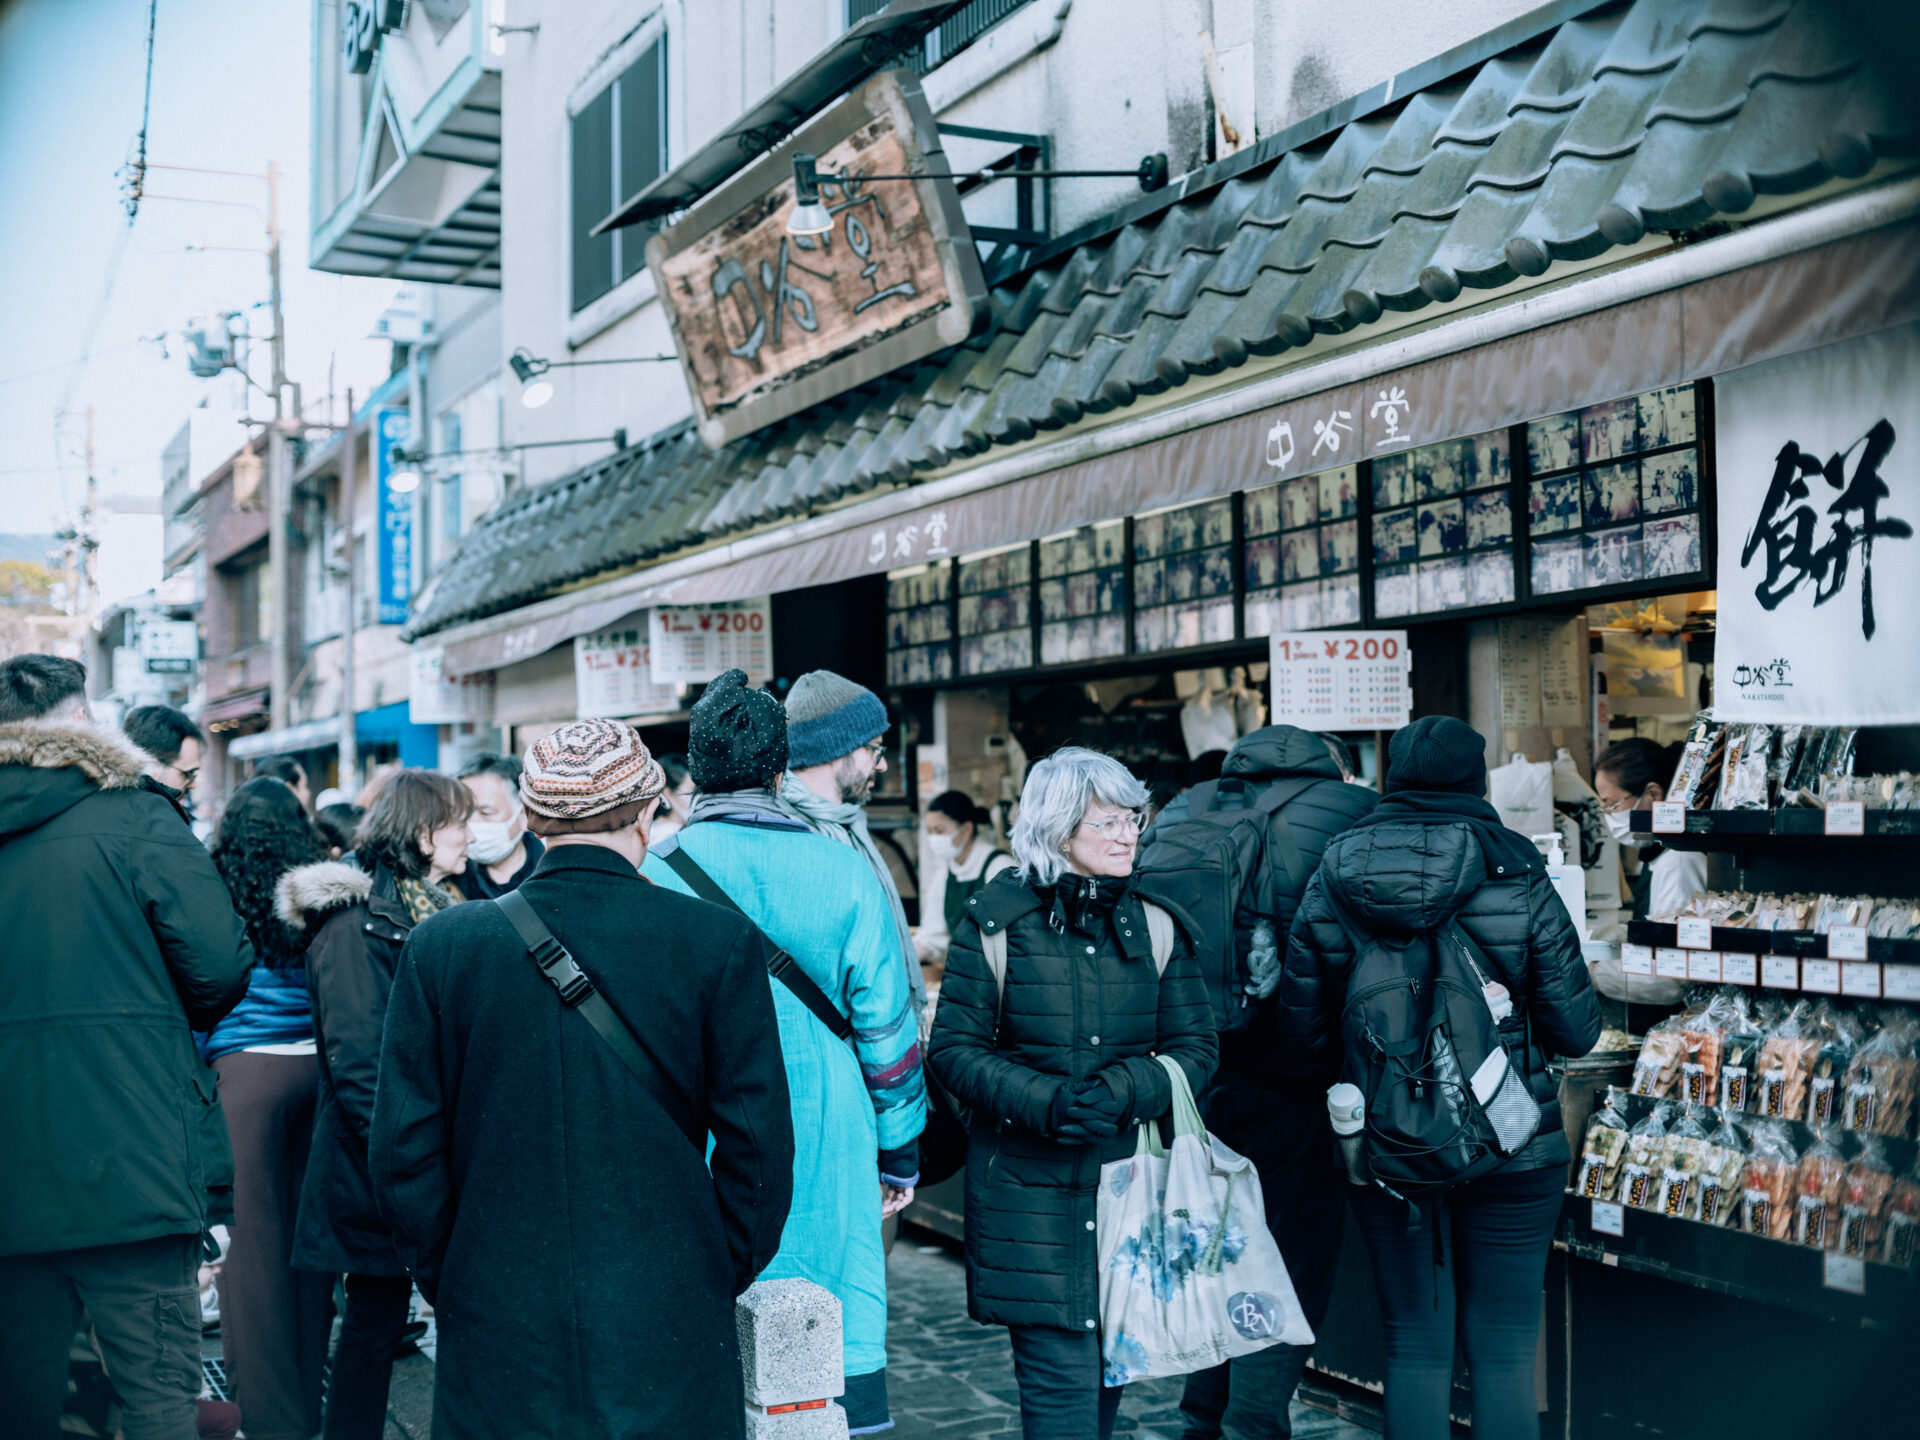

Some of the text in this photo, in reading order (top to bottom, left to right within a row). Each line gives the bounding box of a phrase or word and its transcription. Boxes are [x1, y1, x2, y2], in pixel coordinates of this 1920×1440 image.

[1266, 386, 1411, 472] 中谷堂
[1323, 638, 1398, 660] ¥200
[1733, 658, 1793, 690] 中谷堂
